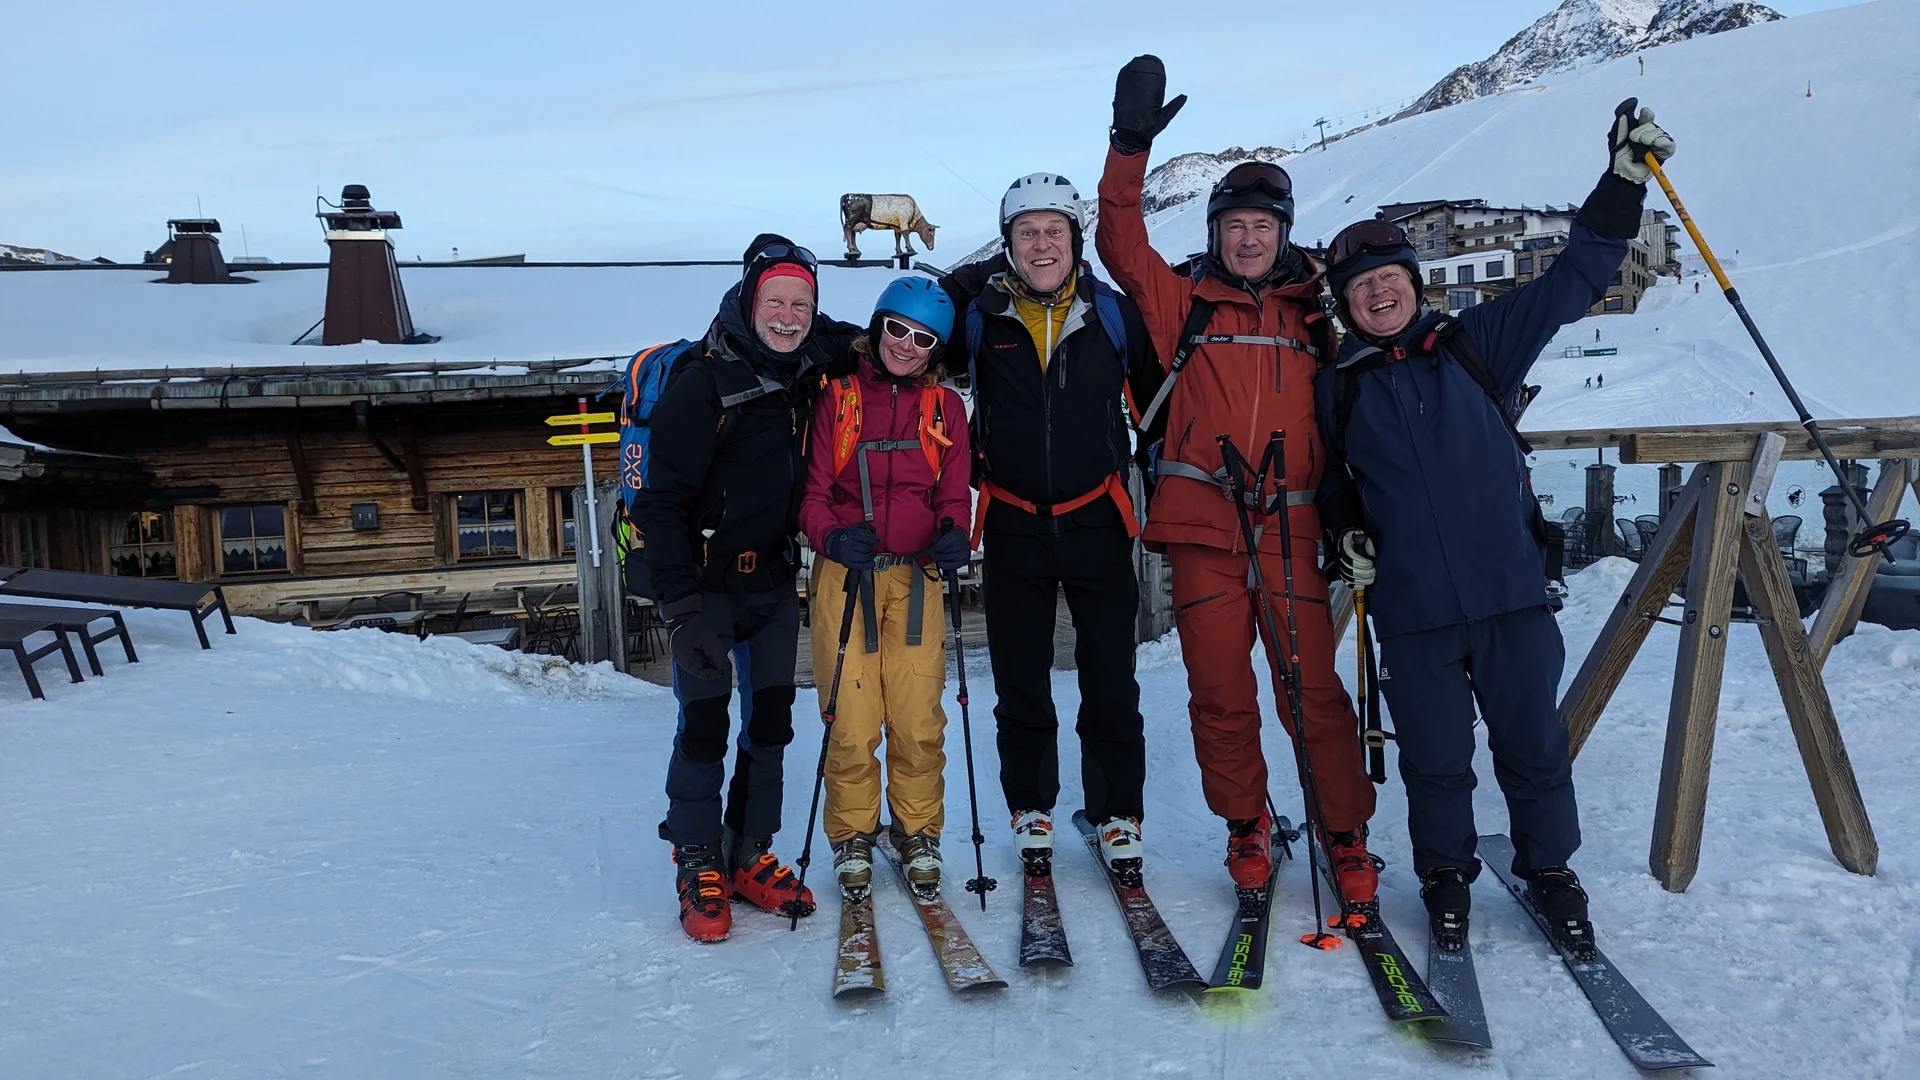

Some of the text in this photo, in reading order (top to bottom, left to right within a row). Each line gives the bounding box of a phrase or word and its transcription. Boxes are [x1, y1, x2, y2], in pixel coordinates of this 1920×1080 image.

[1664, 189, 1691, 223] LEKI
[840, 425, 851, 460] SCOTT
[1253, 473, 1265, 504] LEKI
[1225, 933, 1253, 986] FISCHER
[1374, 952, 1424, 1014] FISCHER
